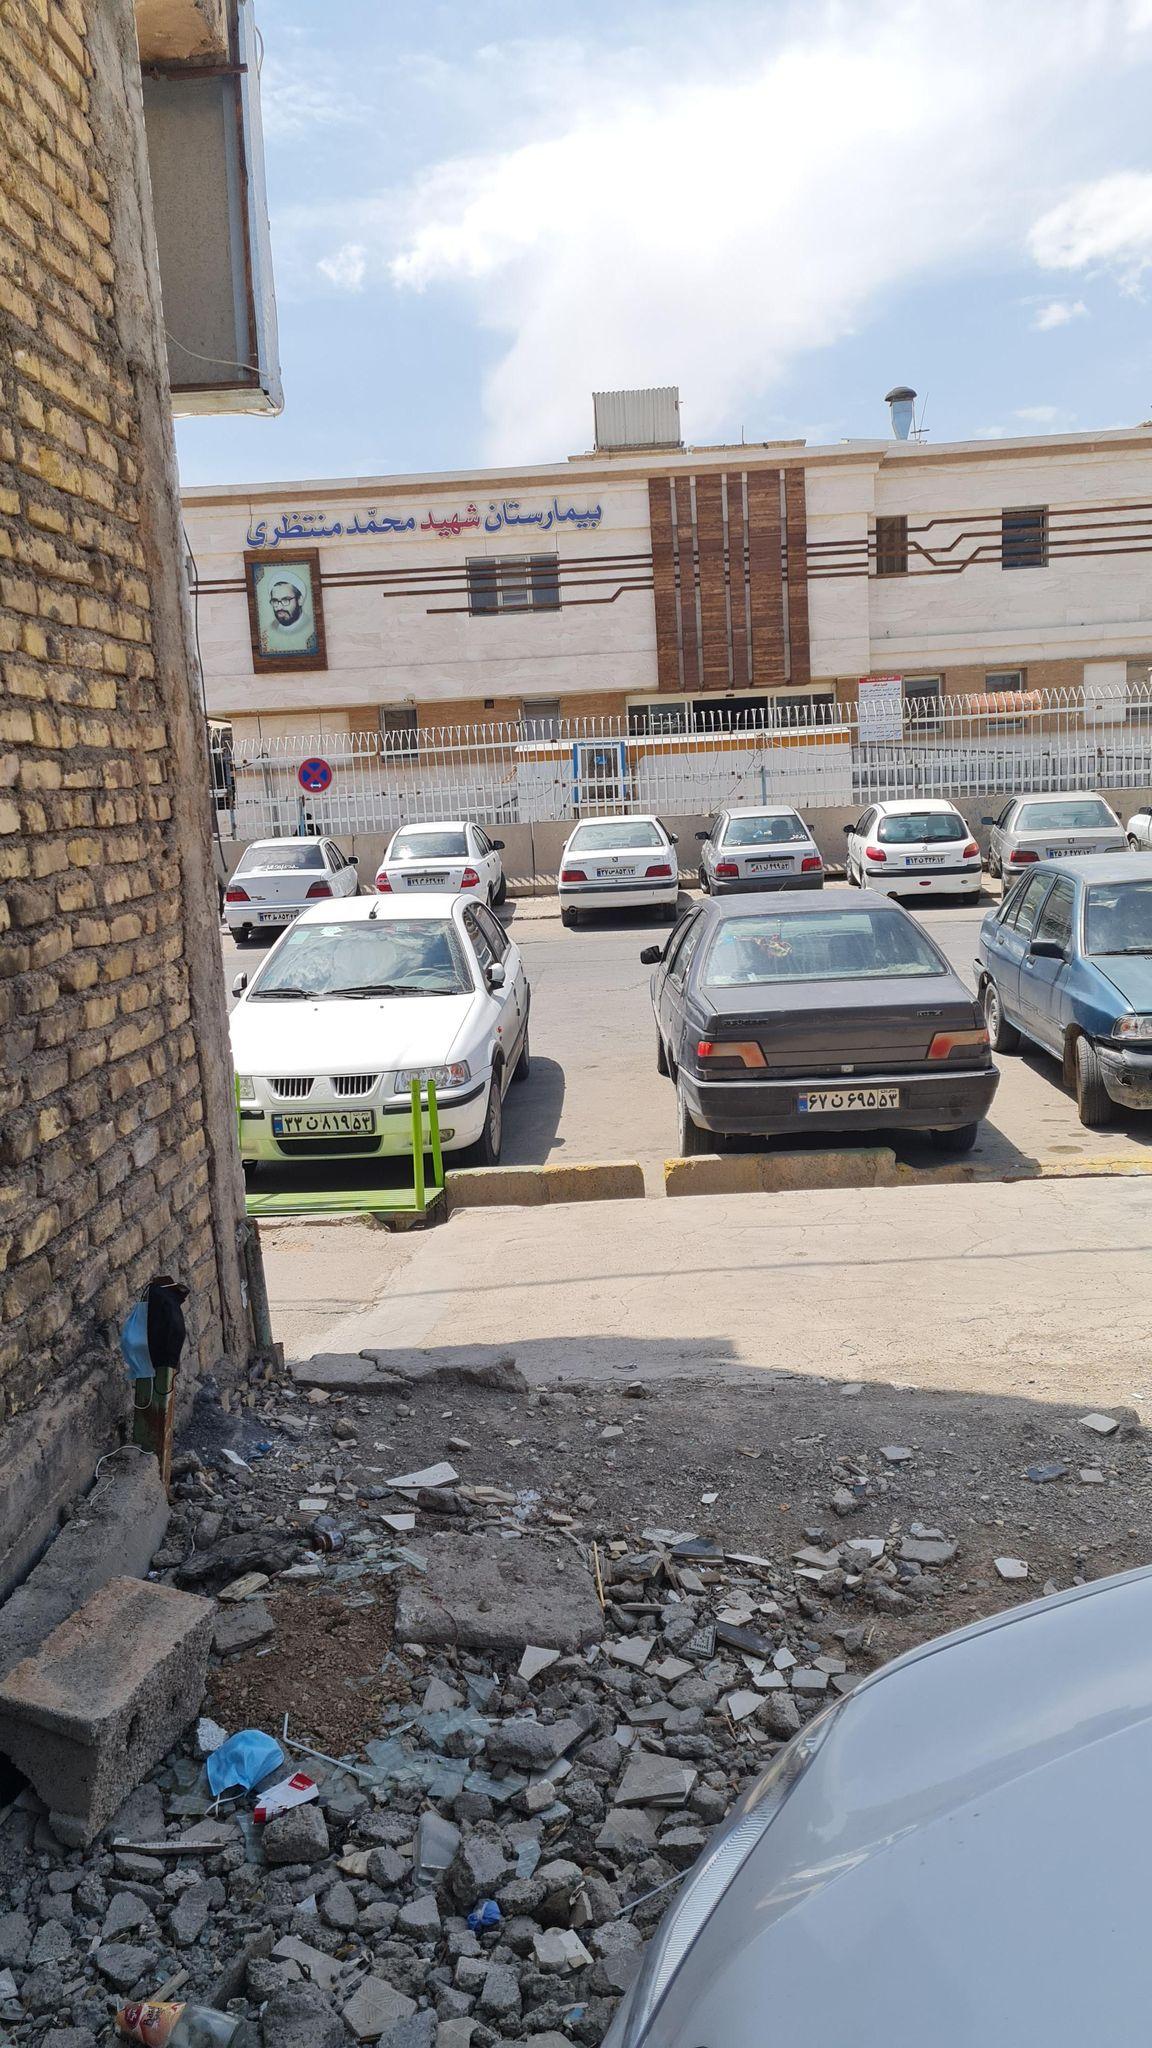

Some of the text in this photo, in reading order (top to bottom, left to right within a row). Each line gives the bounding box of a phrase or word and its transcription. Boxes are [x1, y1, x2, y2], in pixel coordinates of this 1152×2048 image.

[246, 512, 343, 548] منتظری
[420, 503, 480, 537] شهید
[484, 497, 603, 532] بیمارستان
